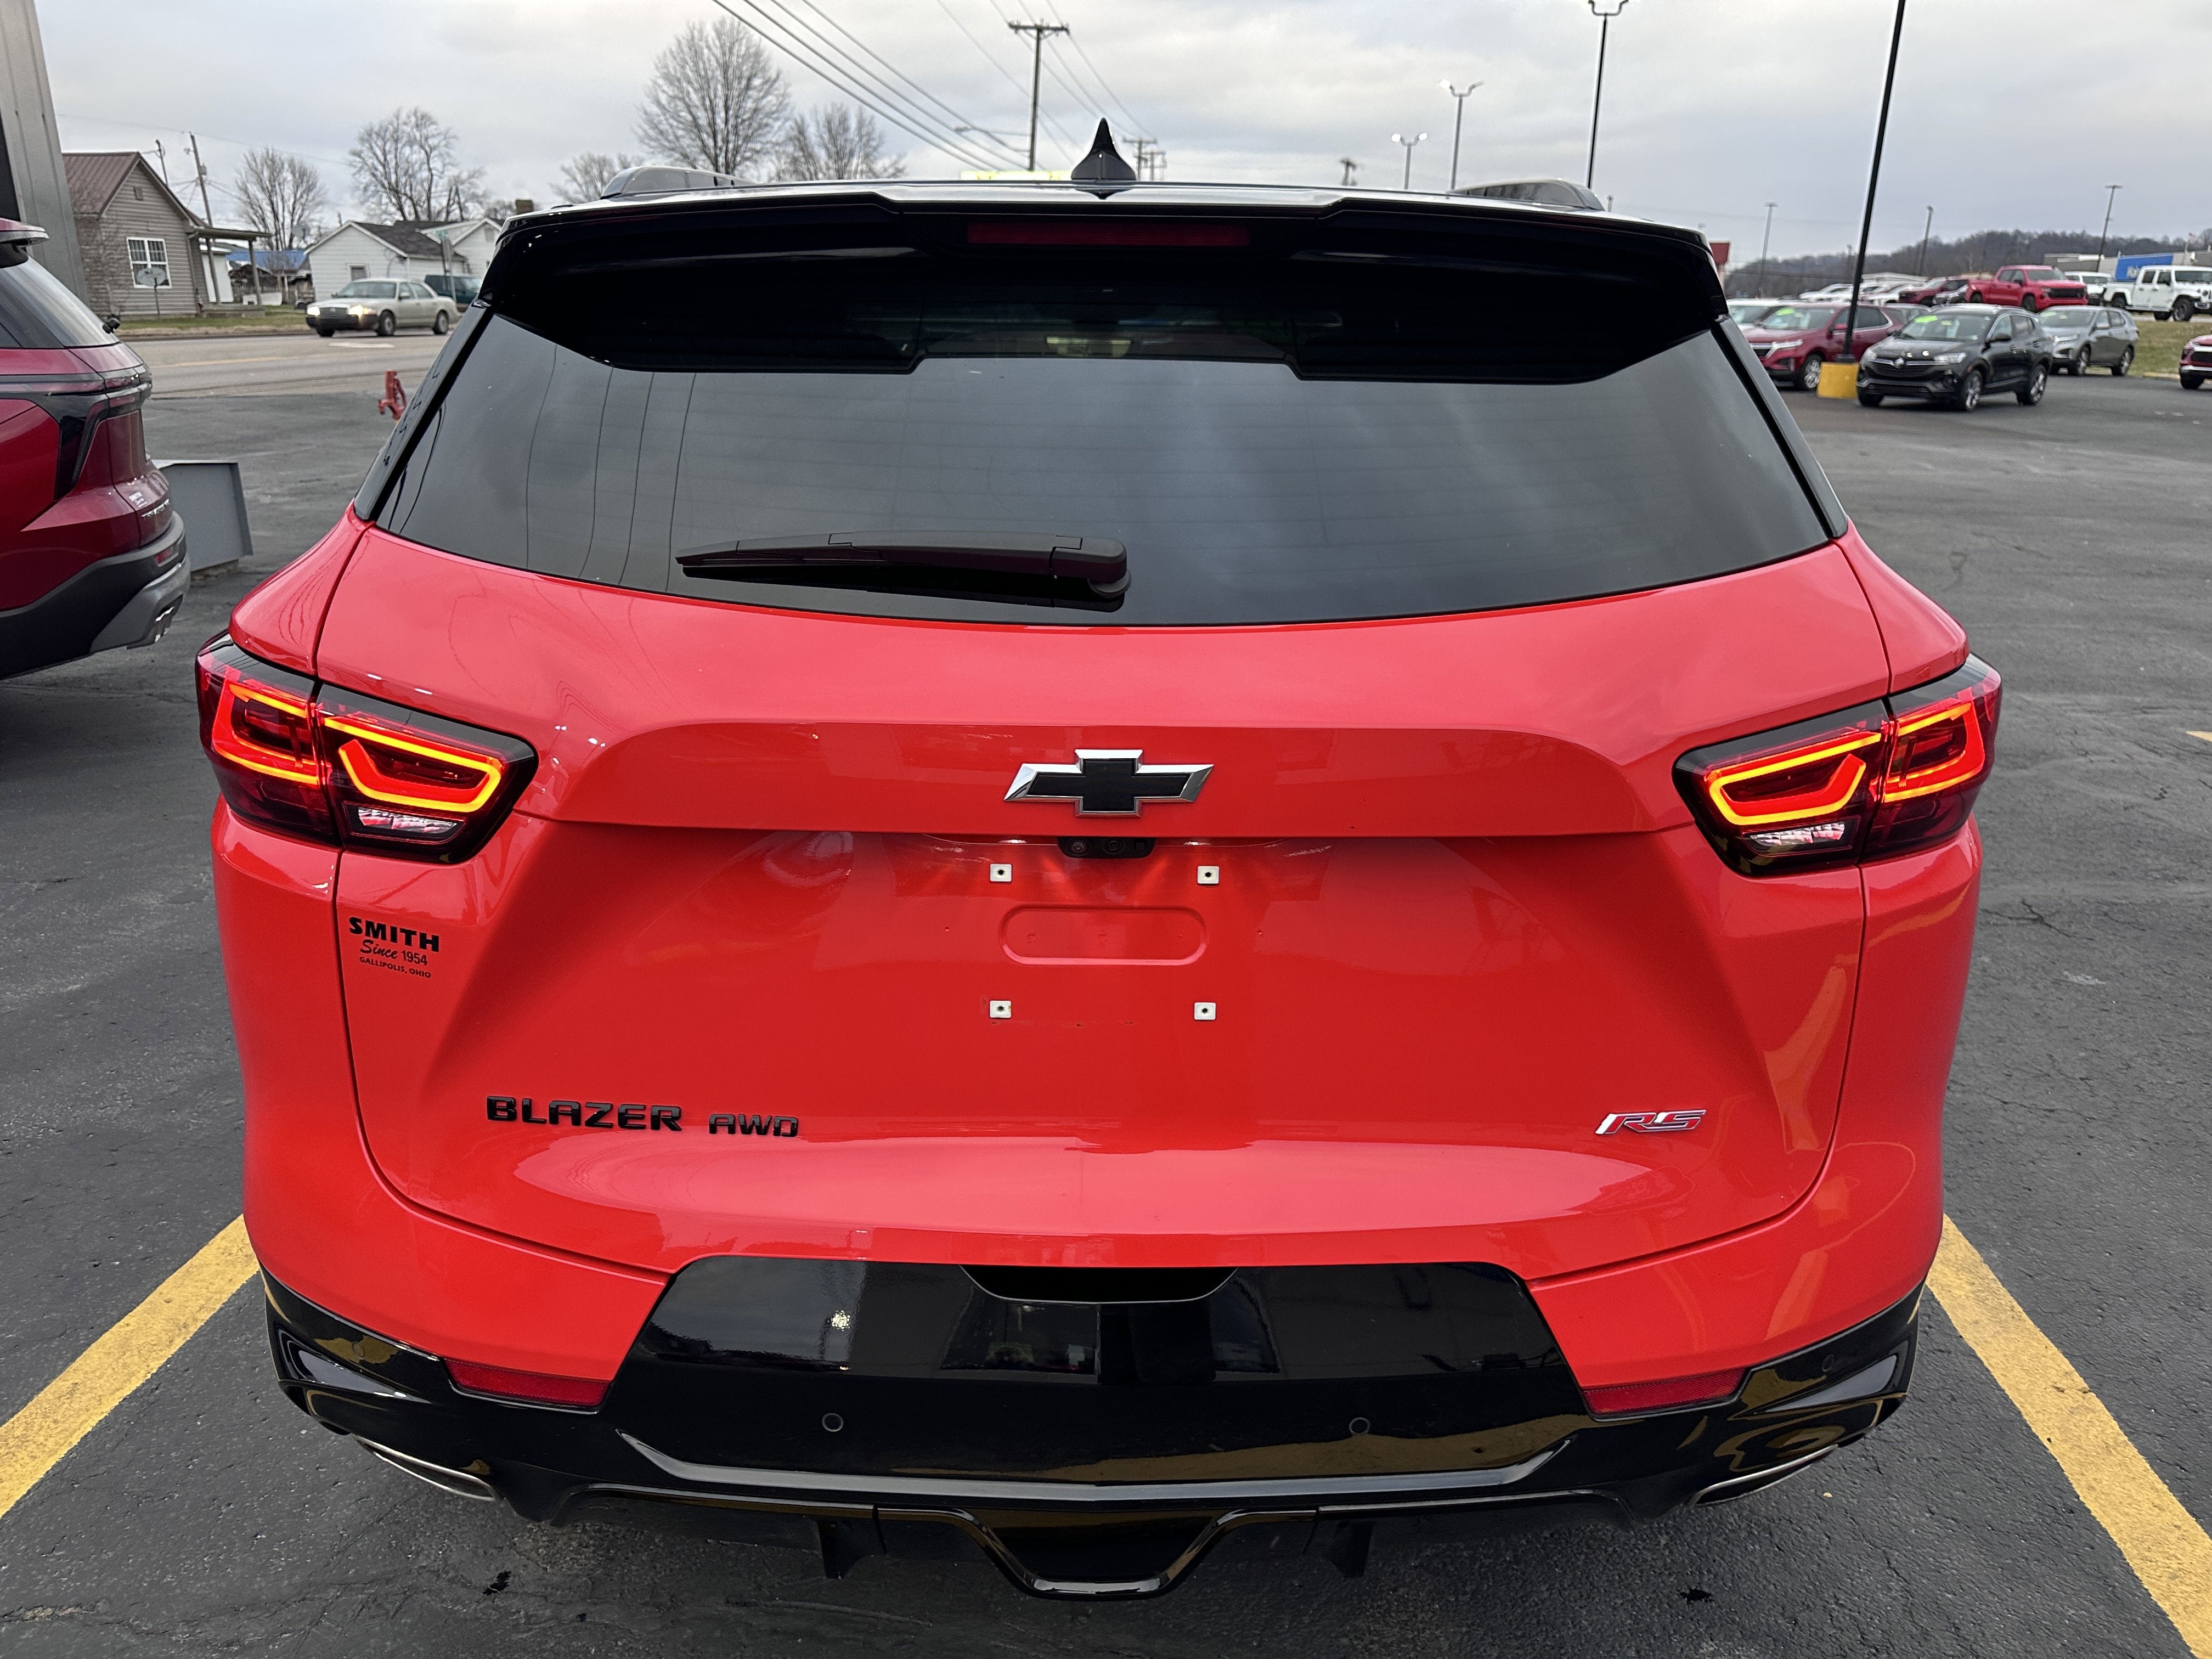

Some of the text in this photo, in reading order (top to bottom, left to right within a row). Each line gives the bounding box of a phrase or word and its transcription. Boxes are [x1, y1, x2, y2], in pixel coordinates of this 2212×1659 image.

[349, 917, 439, 952] SMITH
[360, 939, 428, 966] Since 1954
[359, 956, 431, 978] GALLIPOLIS, OHIO
[486, 1095, 799, 1137] BLAZER AWD
[1595, 1109, 1707, 1135] RS
